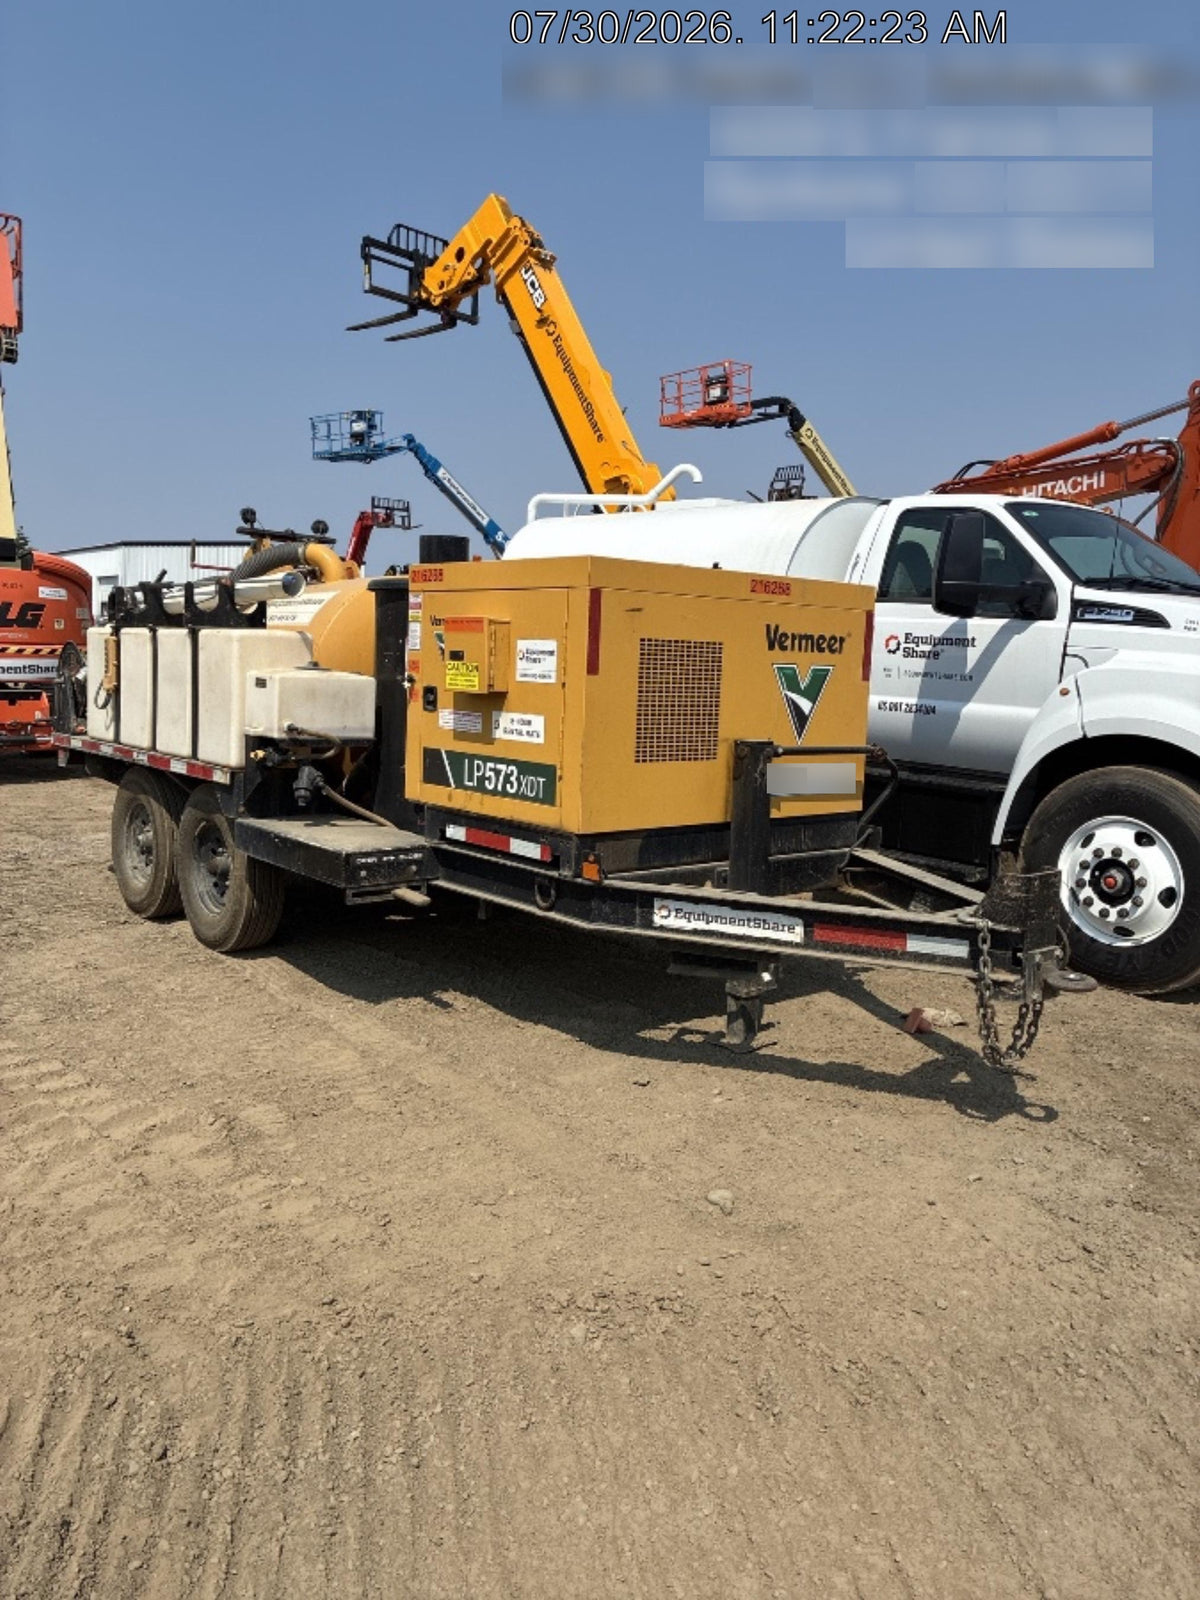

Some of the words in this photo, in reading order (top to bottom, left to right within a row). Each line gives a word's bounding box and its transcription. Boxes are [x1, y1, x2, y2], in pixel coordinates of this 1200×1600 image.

[520, 261, 547, 309] JCB
[552, 332, 606, 444] EquipmentShare
[1023, 469, 1106, 498] HITACHI
[0, 601, 46, 628] LG
[765, 623, 846, 655] Vermeer
[903, 632, 977, 648] Equipment
[902, 646, 941, 660] Share
[447, 662, 479, 673] CAUTION
[673, 907, 798, 934] EquipmentShare
